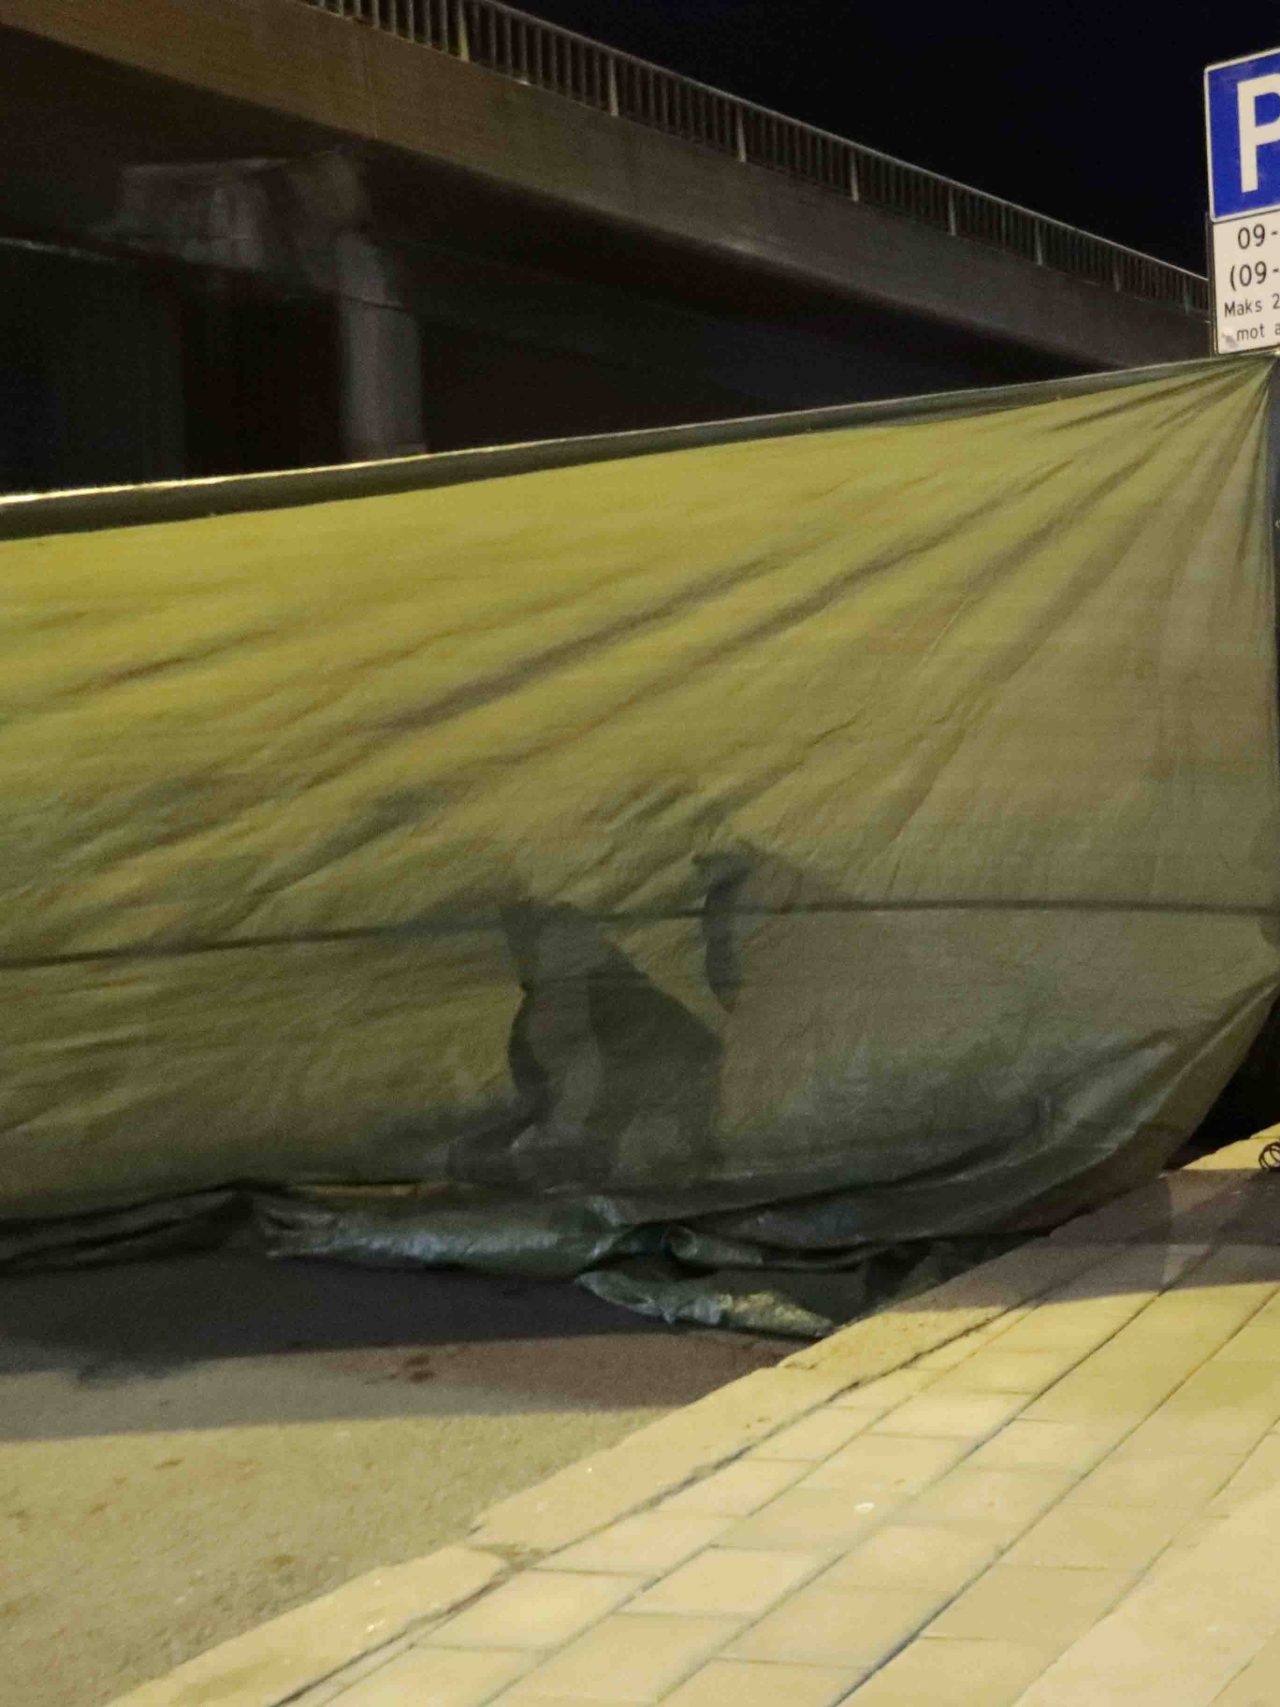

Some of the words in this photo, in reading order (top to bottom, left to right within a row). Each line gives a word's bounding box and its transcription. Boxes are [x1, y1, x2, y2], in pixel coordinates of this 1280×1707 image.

[1224, 301, 1263, 318] Maks
[1272, 293, 1280, 310] 2
[1236, 323, 1265, 342] mot
